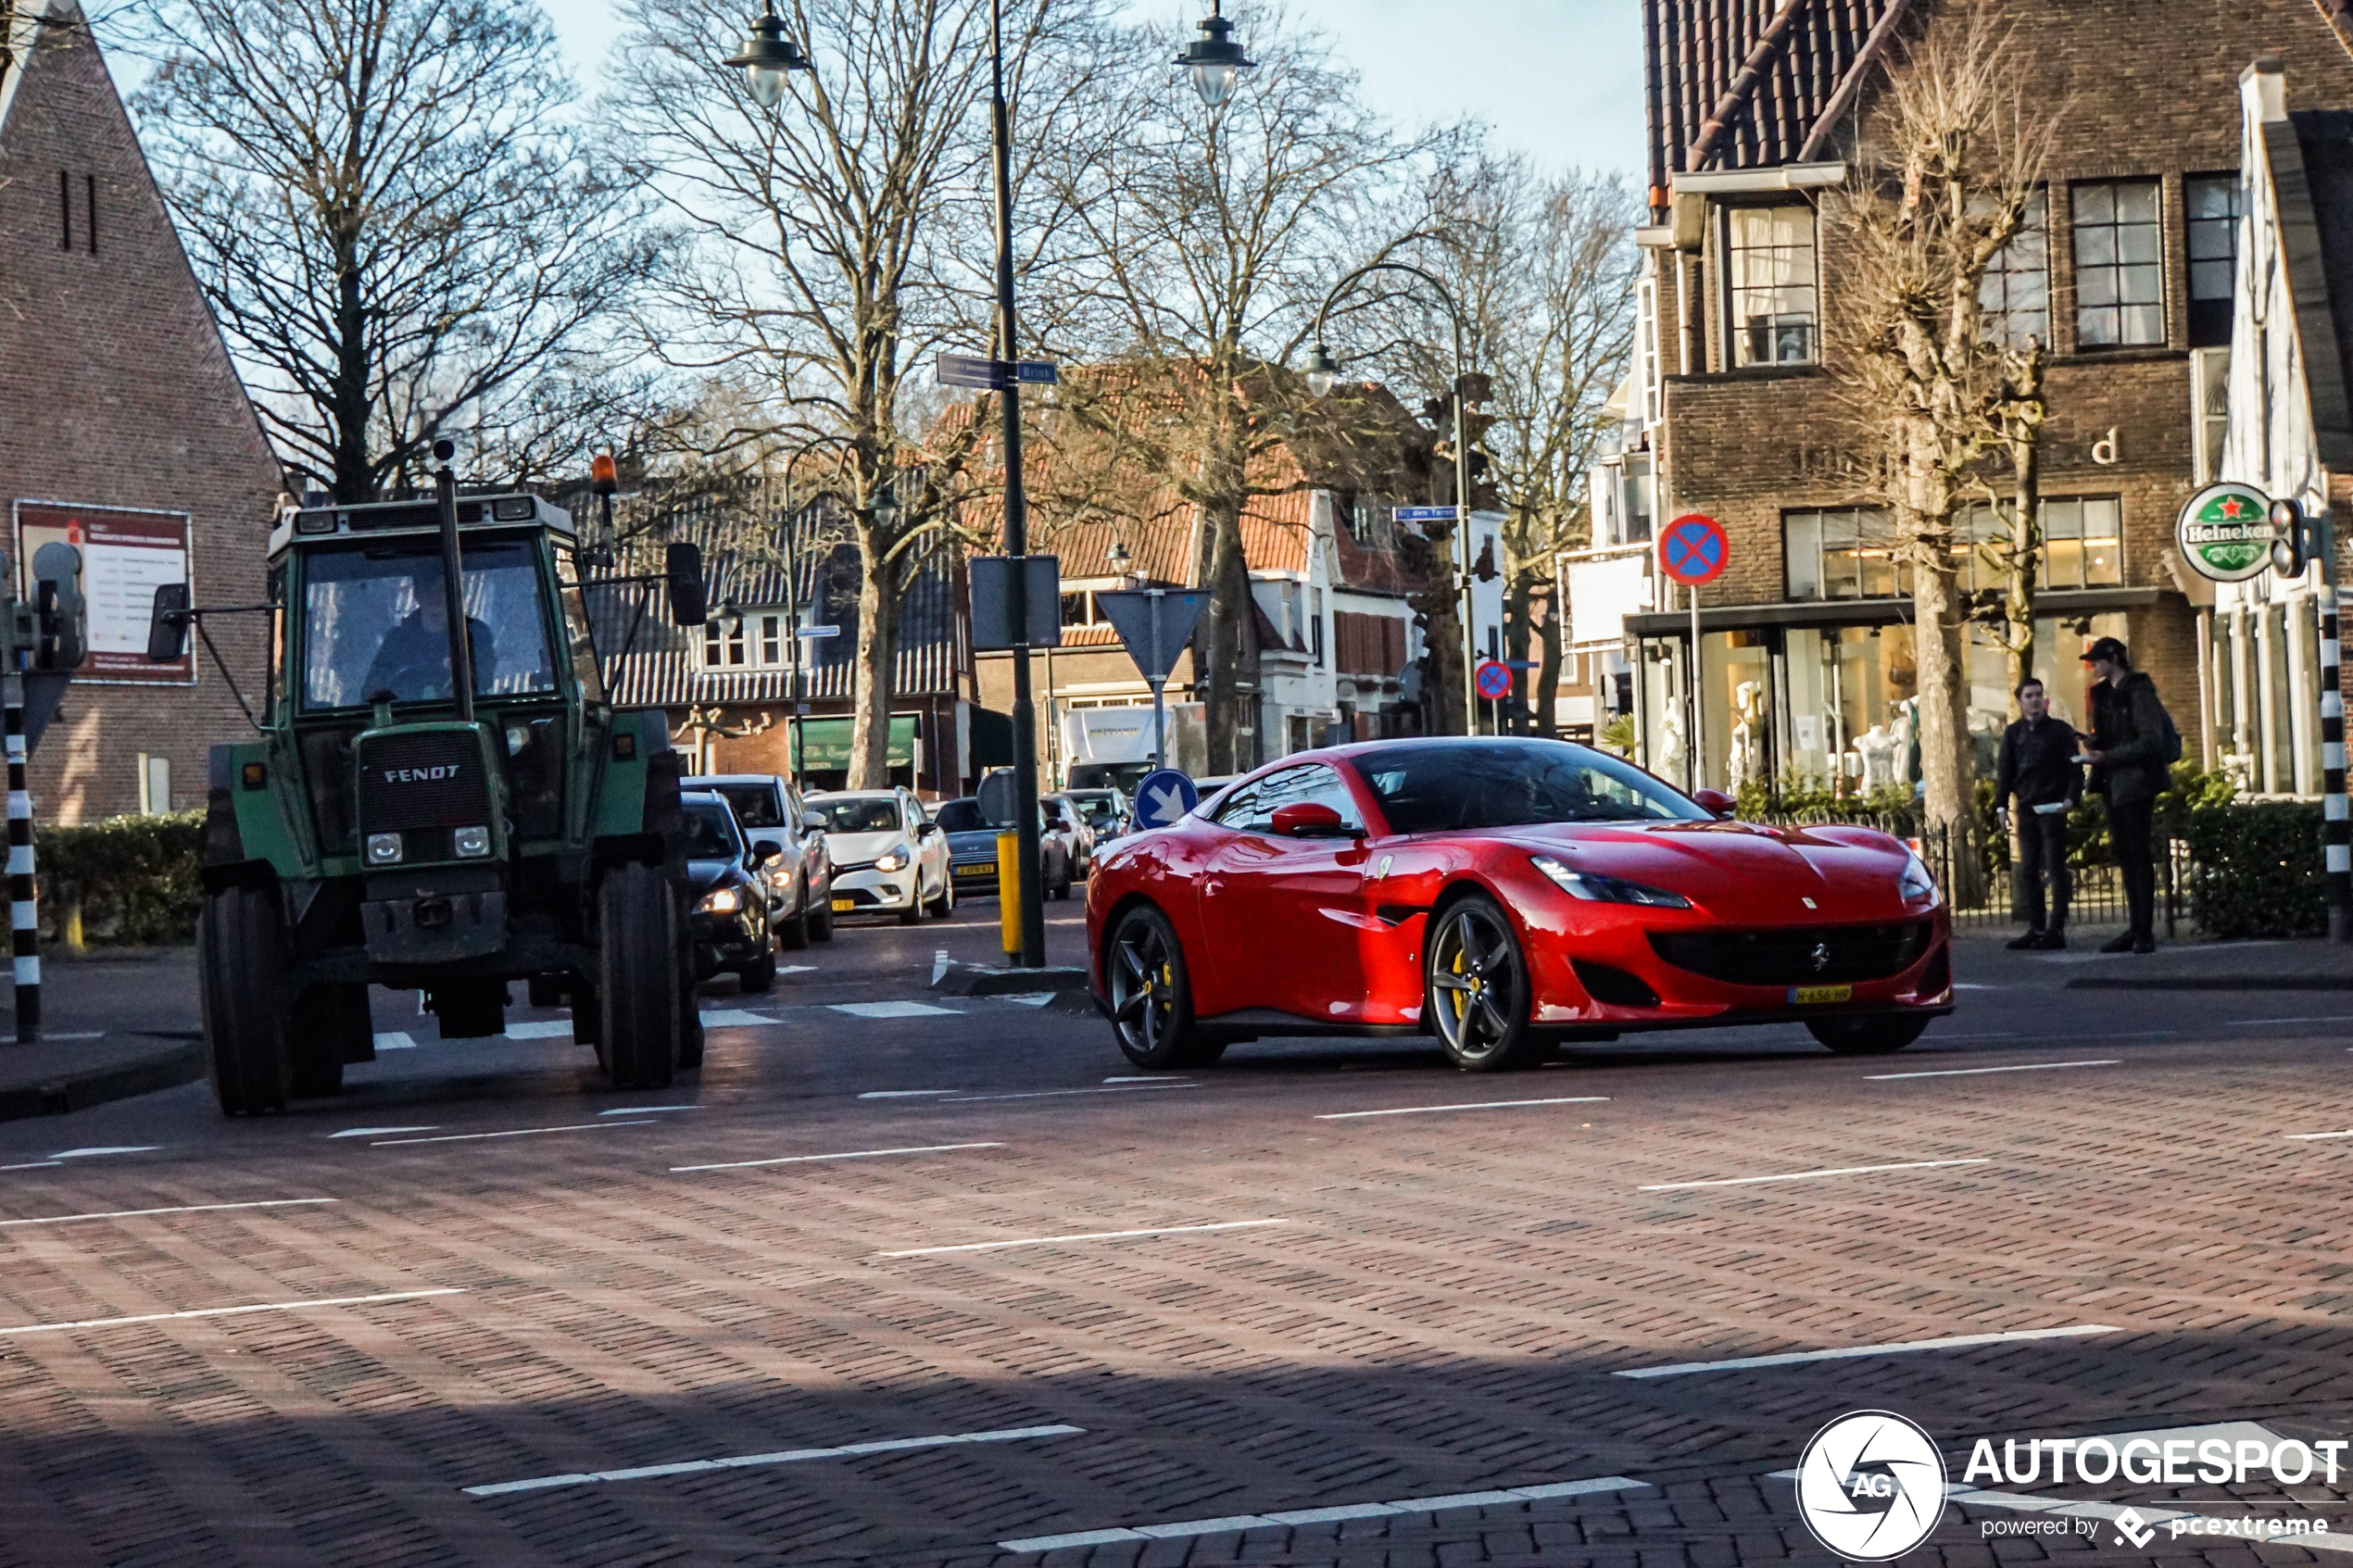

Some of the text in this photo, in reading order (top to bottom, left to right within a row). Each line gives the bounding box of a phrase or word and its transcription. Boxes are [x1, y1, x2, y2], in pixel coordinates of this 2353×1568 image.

[1023, 367, 1051, 377] Brink
[2091, 426, 2118, 464] d
[2187, 522, 2274, 544] Heineken
[384, 765, 460, 783] FENDT
